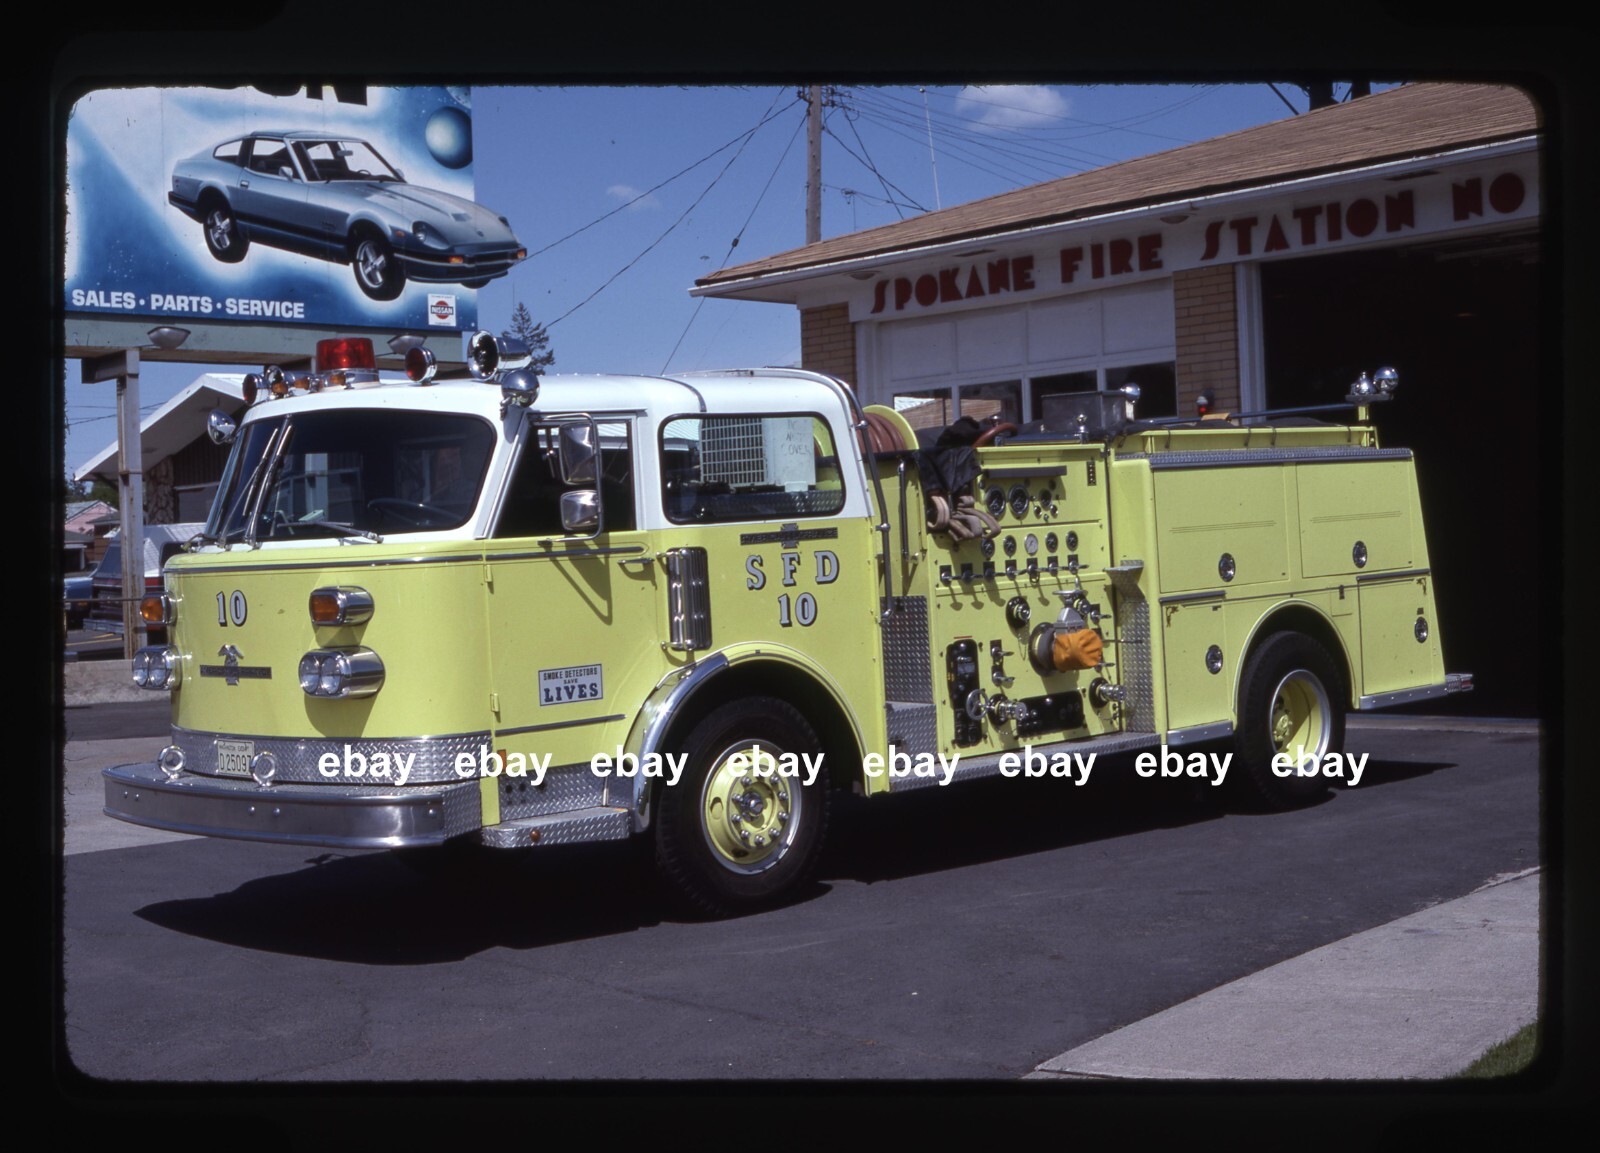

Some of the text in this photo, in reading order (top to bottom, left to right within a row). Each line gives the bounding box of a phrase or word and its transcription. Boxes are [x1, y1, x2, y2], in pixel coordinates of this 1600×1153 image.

[871, 172, 1525, 314] SPOKANE FIRE STATION NO
[72, 289, 305, 319] SALES PARTS SERVICE
[216, 589, 248, 627] 10
[778, 592, 818, 628] 10
[543, 667, 598, 681] SMOKE DETECTORS
[544, 682, 599, 703] LIVES
